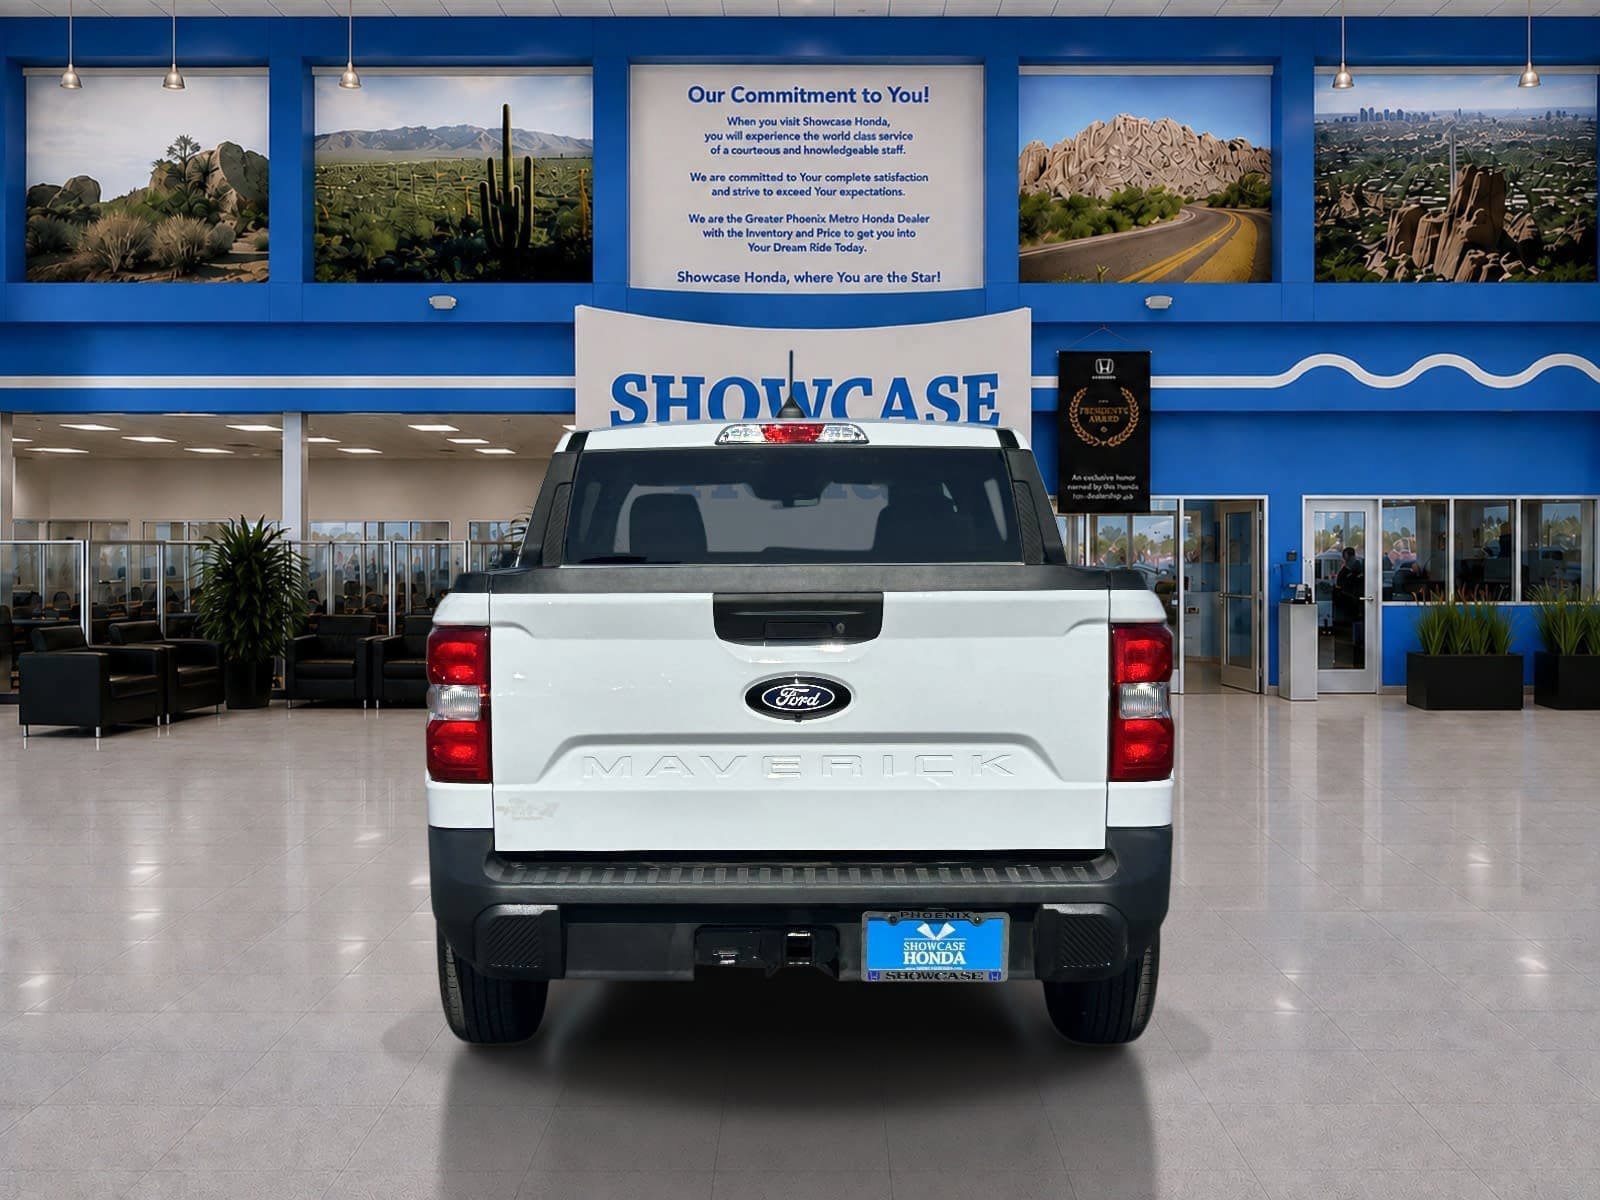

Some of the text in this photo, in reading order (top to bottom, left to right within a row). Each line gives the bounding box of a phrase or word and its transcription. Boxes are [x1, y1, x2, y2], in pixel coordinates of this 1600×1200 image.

[687, 85, 930, 103] Our Commitment to You!
[726, 115, 891, 128] When you visit Showcase Honda,
[704, 130, 914, 143] you will experience the world class service
[709, 144, 722, 155] of
[730, 146, 782, 155] courteous
[782, 144, 802, 154] and
[881, 144, 907, 154] staff.
[689, 171, 929, 184] We are committed to Your complete satisfaction
[711, 185, 906, 199] and strive to exceed Your expectations.
[688, 213, 931, 223] We are the Greater Phoenix Metro Honda Dealer
[702, 227, 917, 240] with the Inventory and Price to get you into
[747, 242, 868, 254] Your Dream Ride Today.
[676, 270, 941, 285] Showcase Honda, where You are the Star!
[610, 373, 1000, 427] SHOWCASE
[775, 687, 821, 707] Ford
[581, 753, 1014, 779] MAVERICK
[900, 911, 972, 920] PHOENIX
[903, 941, 967, 951] SHOWCASE
[903, 951, 967, 965] HONDA
[885, 971, 984, 981] SHOWCASE
